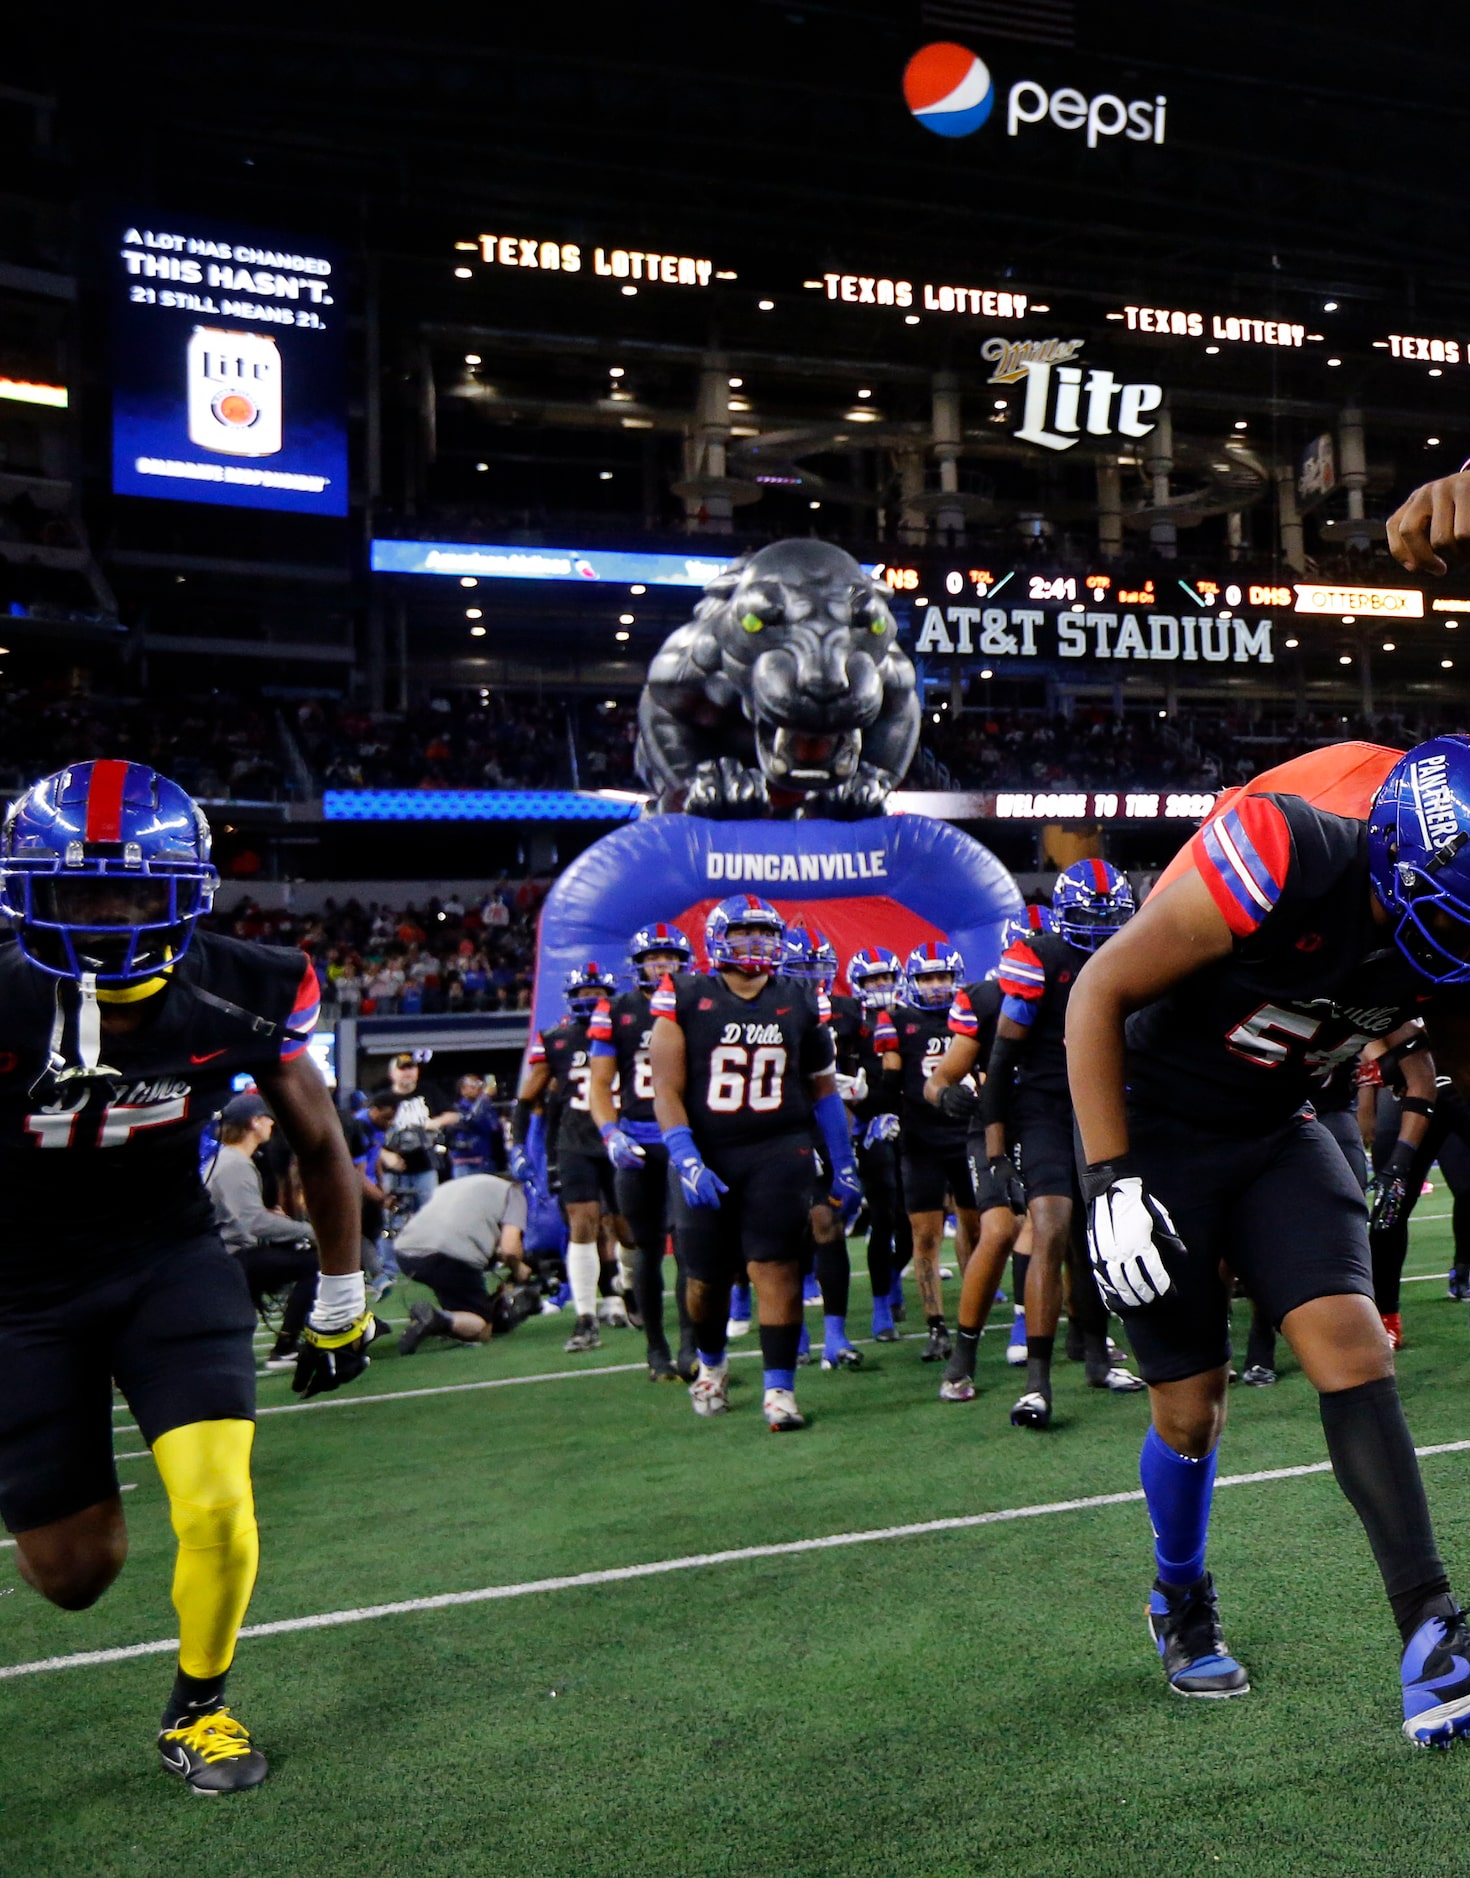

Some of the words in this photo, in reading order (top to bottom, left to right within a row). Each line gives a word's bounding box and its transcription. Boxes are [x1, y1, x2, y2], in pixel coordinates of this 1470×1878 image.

[1006, 80, 1168, 149] pepsi
[124, 227, 143, 245] A
[143, 230, 186, 251] LOT
[187, 238, 232, 259] HAS
[233, 246, 331, 275] CHANGED
[121, 250, 203, 283] THIS
[208, 264, 334, 305] HASN'T.
[130, 286, 156, 304] 21
[159, 290, 220, 314] STILL
[220, 299, 295, 324] MEANS
[295, 310, 327, 329] 21.
[981, 337, 1086, 380] Miller
[1013, 360, 1163, 450] Lite
[946, 571, 964, 594] 0
[1029, 576, 1076, 600] 2:41
[1225, 585, 1242, 606] 0
[1248, 585, 1292, 606] DHS
[1311, 590, 1409, 612] OTTERBOX
[915, 605, 1045, 656] AT&T
[1057, 611, 1275, 664] STADIUM
[996, 793, 1087, 818] WELCOME
[1094, 793, 1118, 818] TO
[1125, 794, 1159, 818] THE
[707, 850, 888, 882] DUNCANVILLE
[706, 1046, 788, 1113] 60
